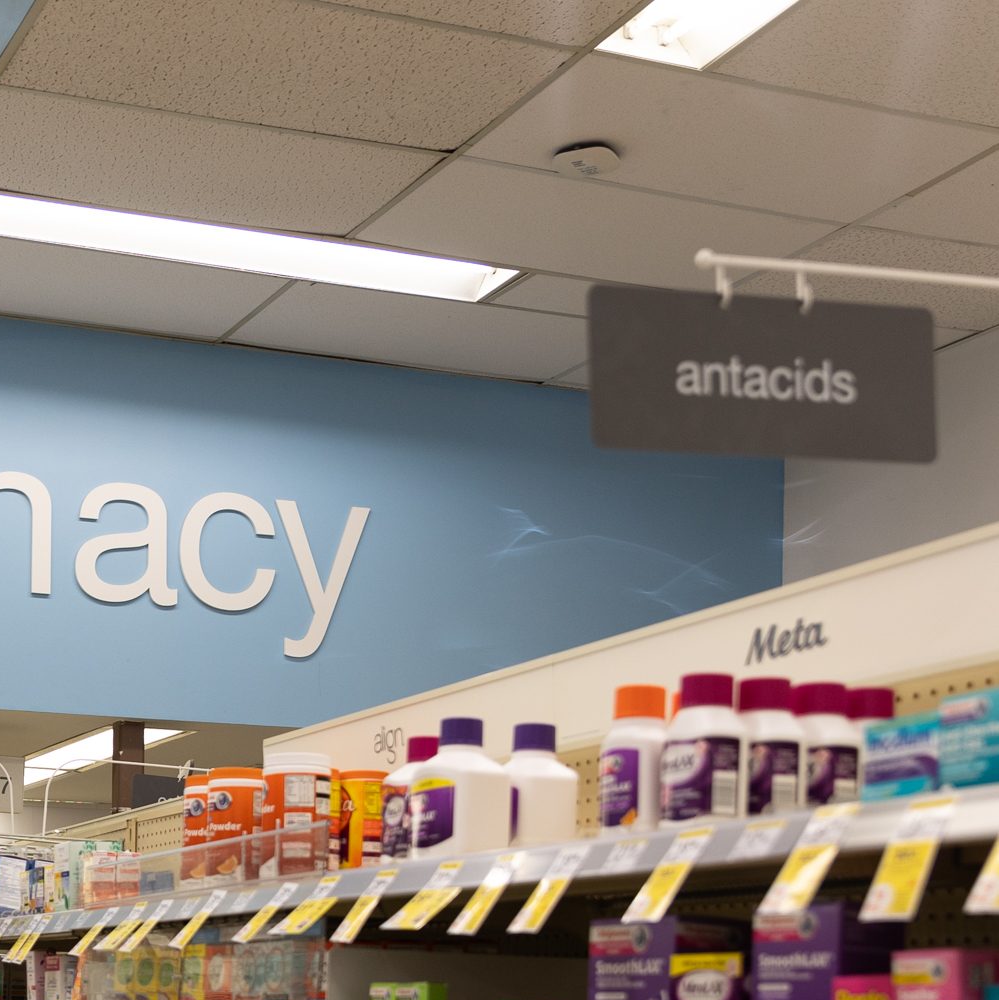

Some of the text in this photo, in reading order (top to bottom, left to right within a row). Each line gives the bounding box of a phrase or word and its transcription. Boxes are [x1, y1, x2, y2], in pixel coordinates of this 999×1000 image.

[675, 356, 858, 406] antacids
[745, 617, 829, 666] Meta
[373, 725, 404, 764] align
[0, 776, 12, 795] 7
[209, 821, 242, 832] Powder
